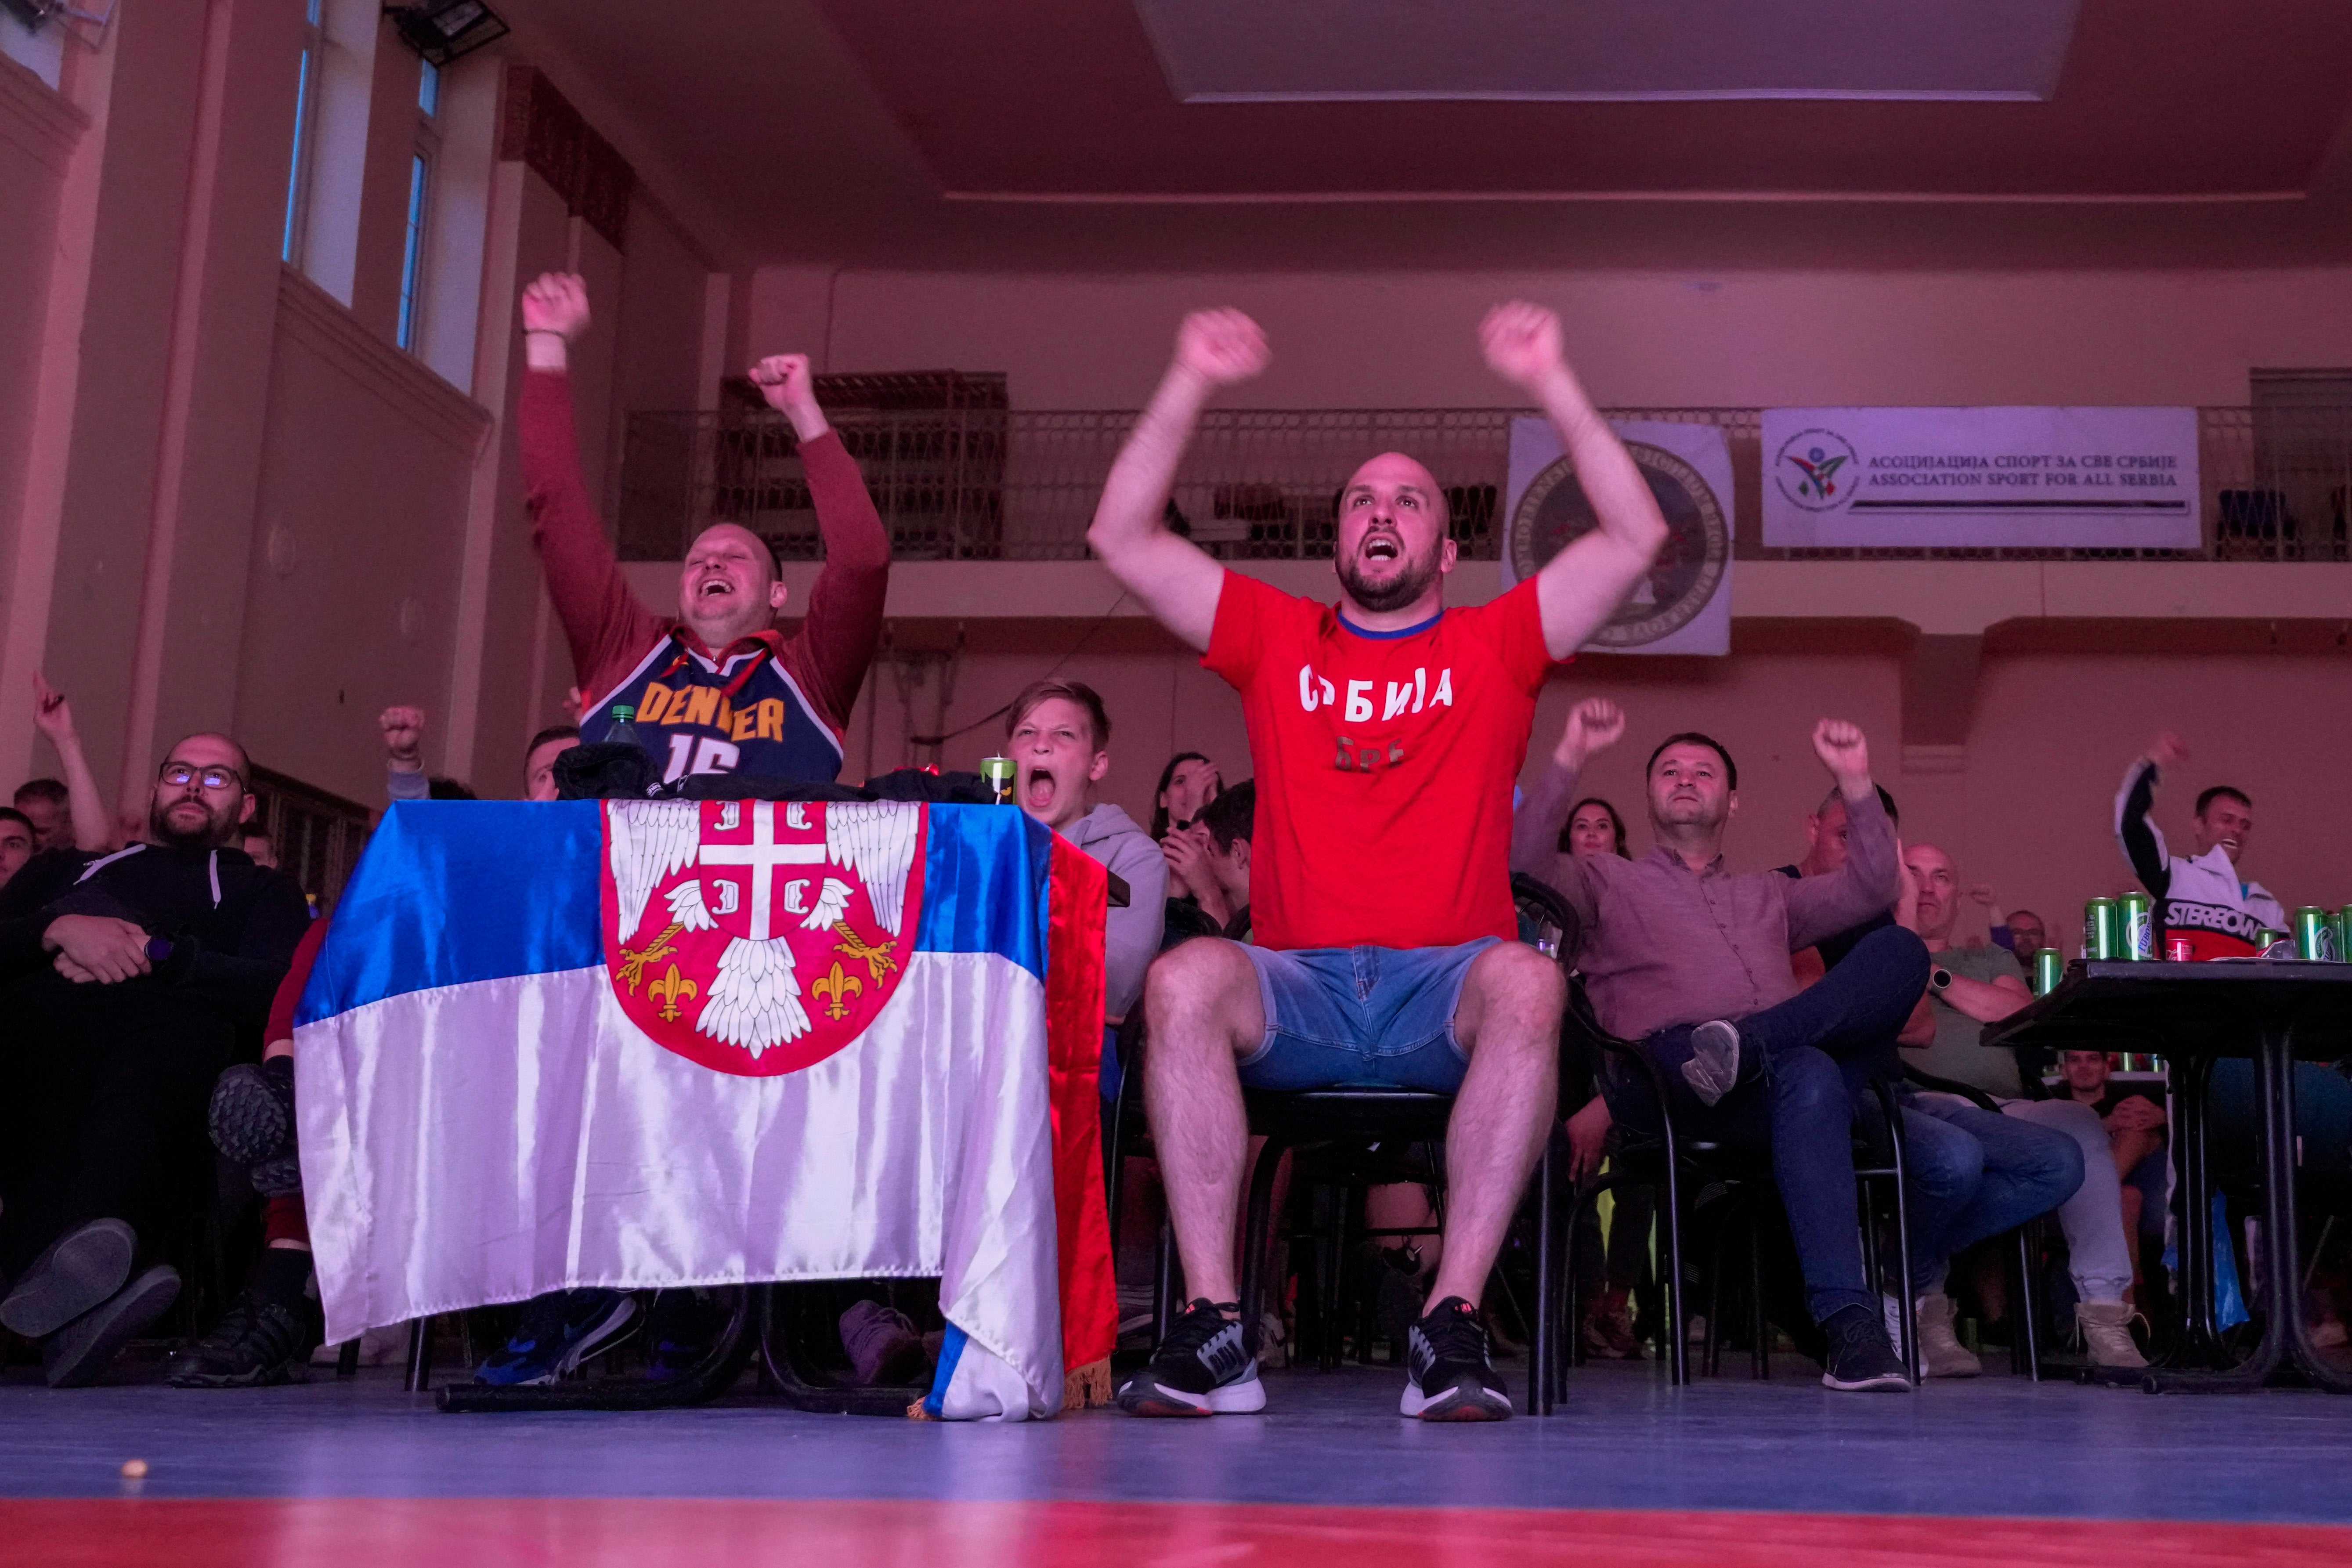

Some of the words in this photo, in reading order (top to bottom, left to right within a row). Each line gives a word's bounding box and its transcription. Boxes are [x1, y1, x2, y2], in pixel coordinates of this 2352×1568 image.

[1994, 455, 2052, 468] СПОРТ
[2056, 455, 2077, 468] ЗА
[2081, 455, 2113, 468] СВЕ
[2116, 455, 2177, 470] СРБИЈЕ
[1868, 473, 1982, 486] ASSOCIATION
[1987, 473, 2039, 486] SPORT
[2045, 473, 2077, 486] FOR
[2083, 473, 2114, 486] ALL
[2119, 473, 2177, 487] SERBIA
[635, 682, 784, 742] DENVER
